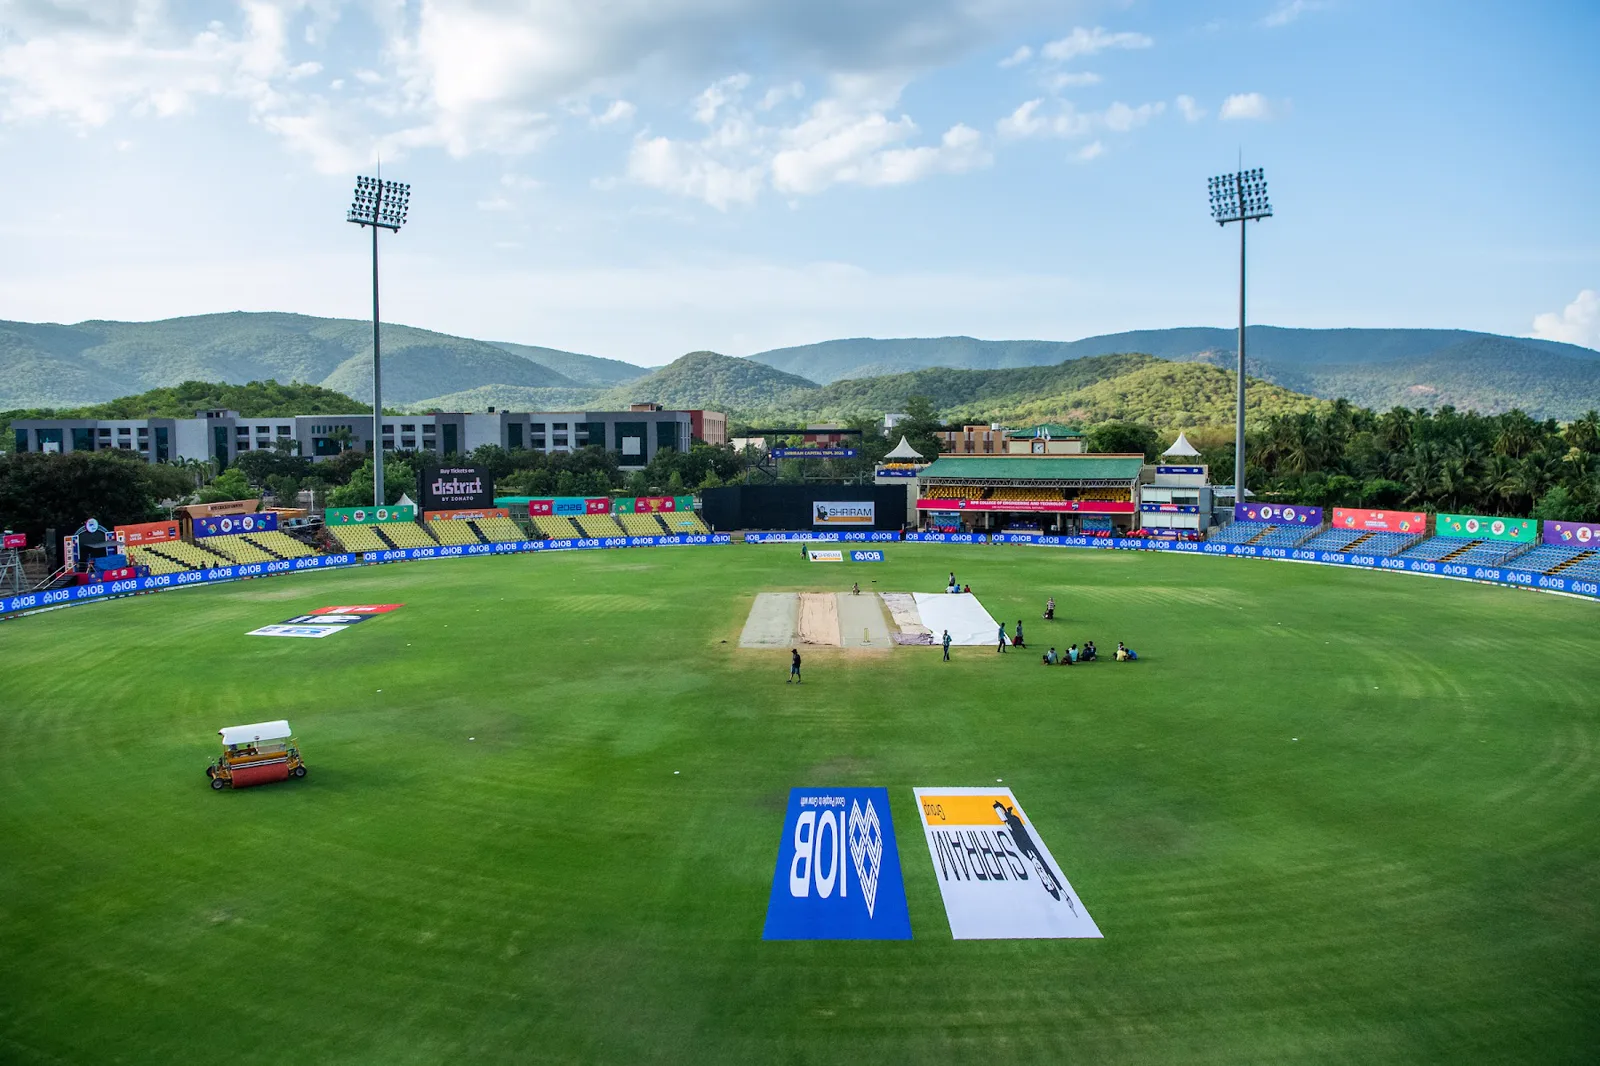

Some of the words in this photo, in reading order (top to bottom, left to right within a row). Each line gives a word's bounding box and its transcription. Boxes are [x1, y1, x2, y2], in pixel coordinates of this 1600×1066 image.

[432, 476, 483, 495] district
[556, 504, 582, 512] 2026
[829, 508, 872, 516] SHRIRAM
[392, 550, 406, 558] IOB
[448, 546, 462, 554] IOB
[864, 551, 880, 560] IOB
[20, 596, 36, 606] IOB
[53, 590, 69, 600] IOB
[88, 584, 104, 595] IOB
[122, 580, 137, 590] IOB
[154, 576, 170, 585] IOB
[186, 572, 202, 581] IOB
[218, 568, 232, 577] IOB
[248, 564, 261, 574] IOB
[276, 561, 290, 570] IOB
[304, 558, 318, 566] IOB
[1300, 551, 1315, 559] IOB
[1330, 554, 1344, 562] IOB
[1360, 556, 1374, 565] IOB
[1390, 559, 1404, 568] IOB
[1420, 562, 1436, 572] IOB
[1452, 566, 1468, 575] IOB
[1484, 570, 1500, 579] IOB
[1516, 574, 1532, 584] IOB
[1549, 578, 1564, 588] IOB
[1581, 583, 1597, 594] IOB
[835, 797, 846, 807] Good
[923, 800, 946, 820] Group
[789, 810, 846, 899] IOB
[931, 830, 1029, 881] SHRIRAM
